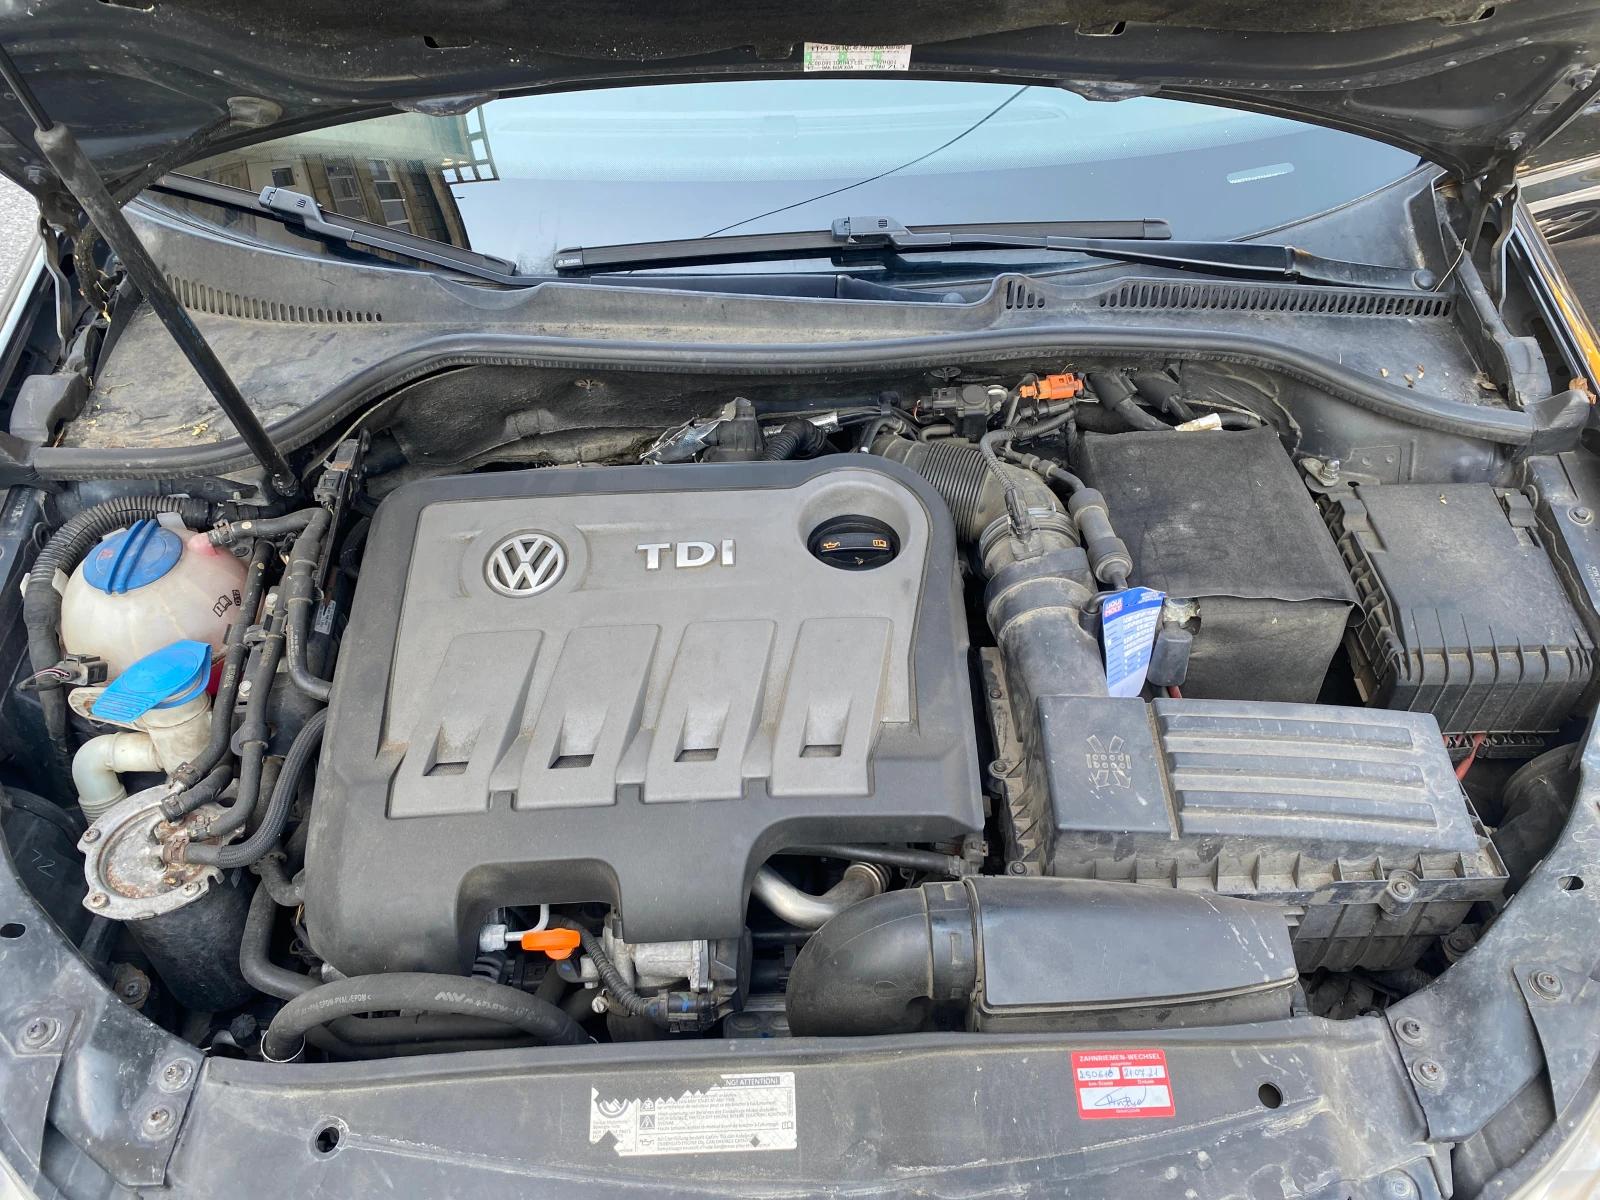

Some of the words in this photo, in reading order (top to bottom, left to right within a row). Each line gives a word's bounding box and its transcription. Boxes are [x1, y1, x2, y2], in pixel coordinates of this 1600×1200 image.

[636, 539, 734, 570] TDI
[1079, 1053, 1161, 1062] ZAHNRIEMEN-WECHSEL
[739, 1077, 778, 1086] ATTENTION!
